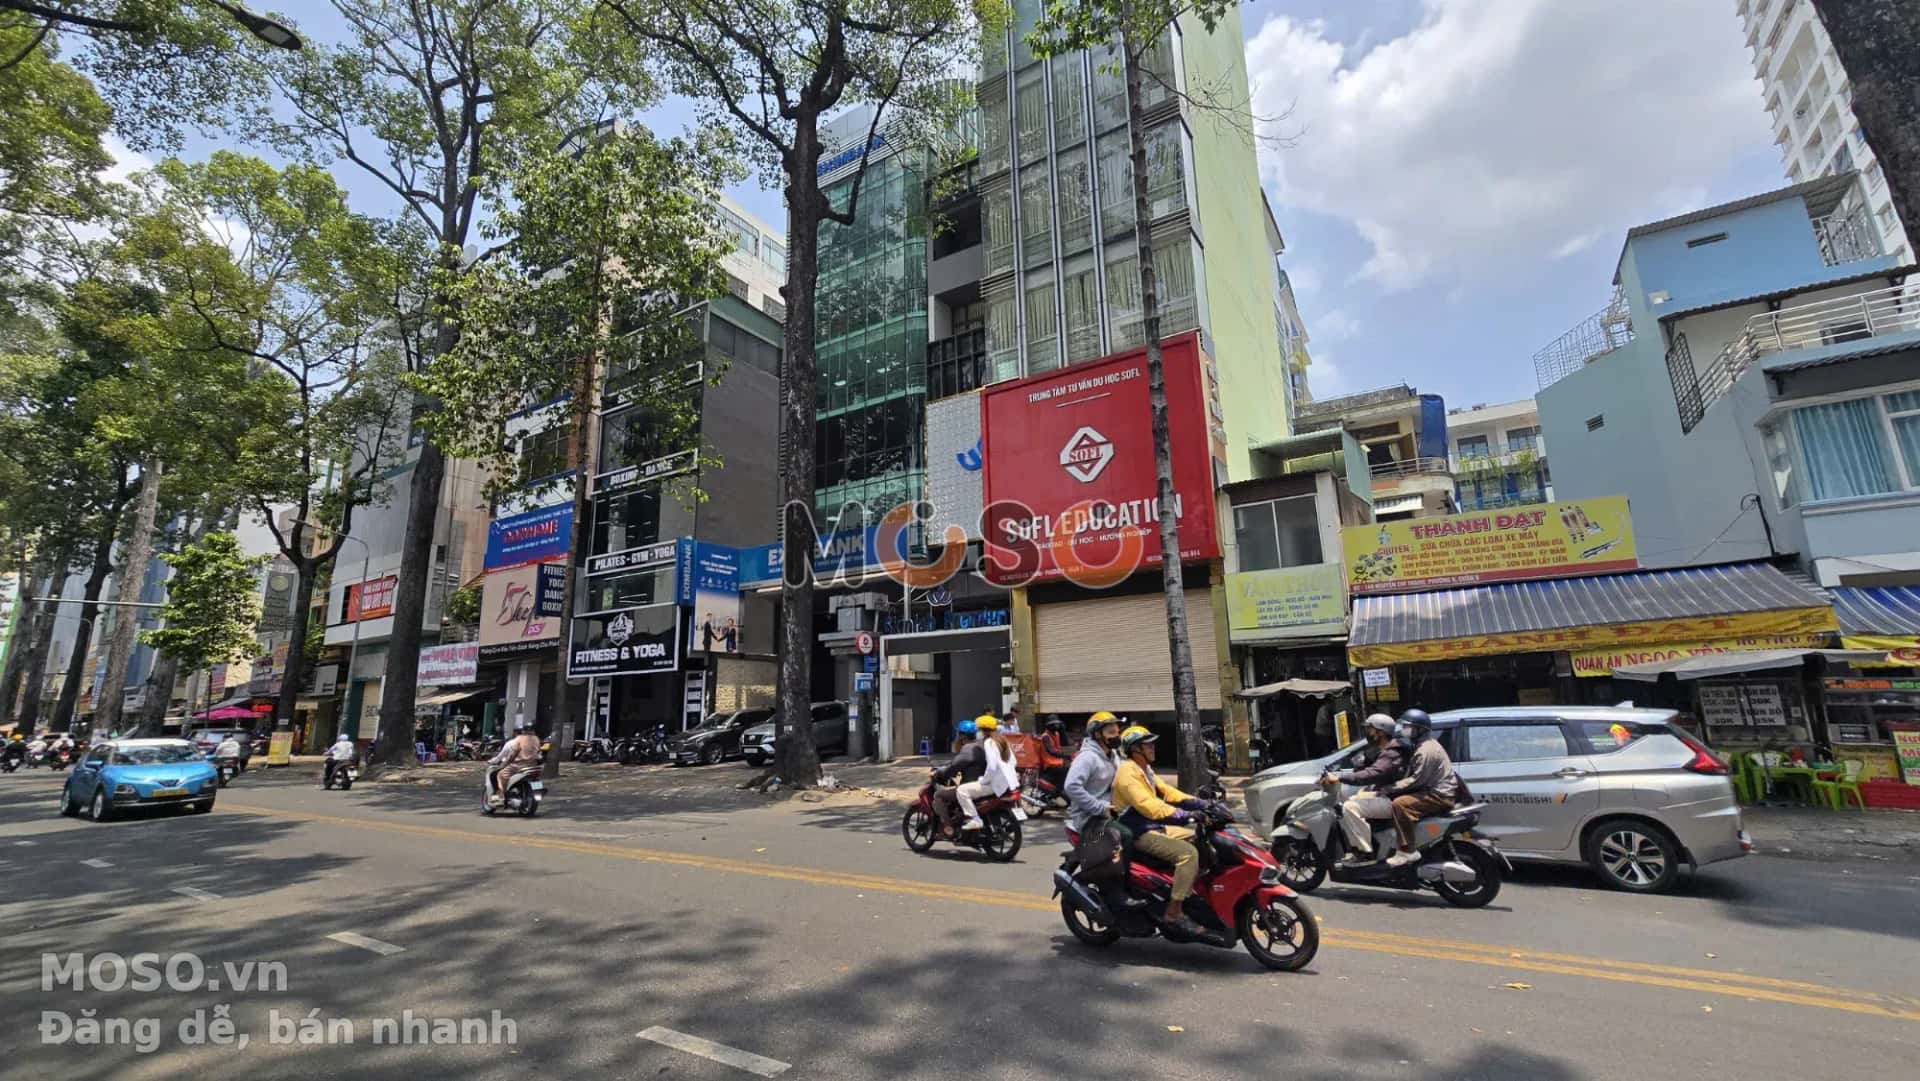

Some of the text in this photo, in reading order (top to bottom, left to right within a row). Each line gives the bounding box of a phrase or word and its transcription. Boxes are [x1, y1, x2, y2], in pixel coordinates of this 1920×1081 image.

[1029, 388, 1051, 403] TRUNG
[1121, 367, 1141, 380] SOFL
[1006, 515, 1056, 543] SOFL
[1410, 510, 1546, 540] THÀNH ĐẠT
[1506, 532, 1518, 542] XE
[595, 545, 675, 571] PILATES GYM YOGA
[768, 533, 864, 566] EBANK
[544, 590, 564, 602] DANC
[575, 647, 618, 664] FITNESS
[620, 646, 631, 660] &
[634, 643, 666, 659] YOGA
